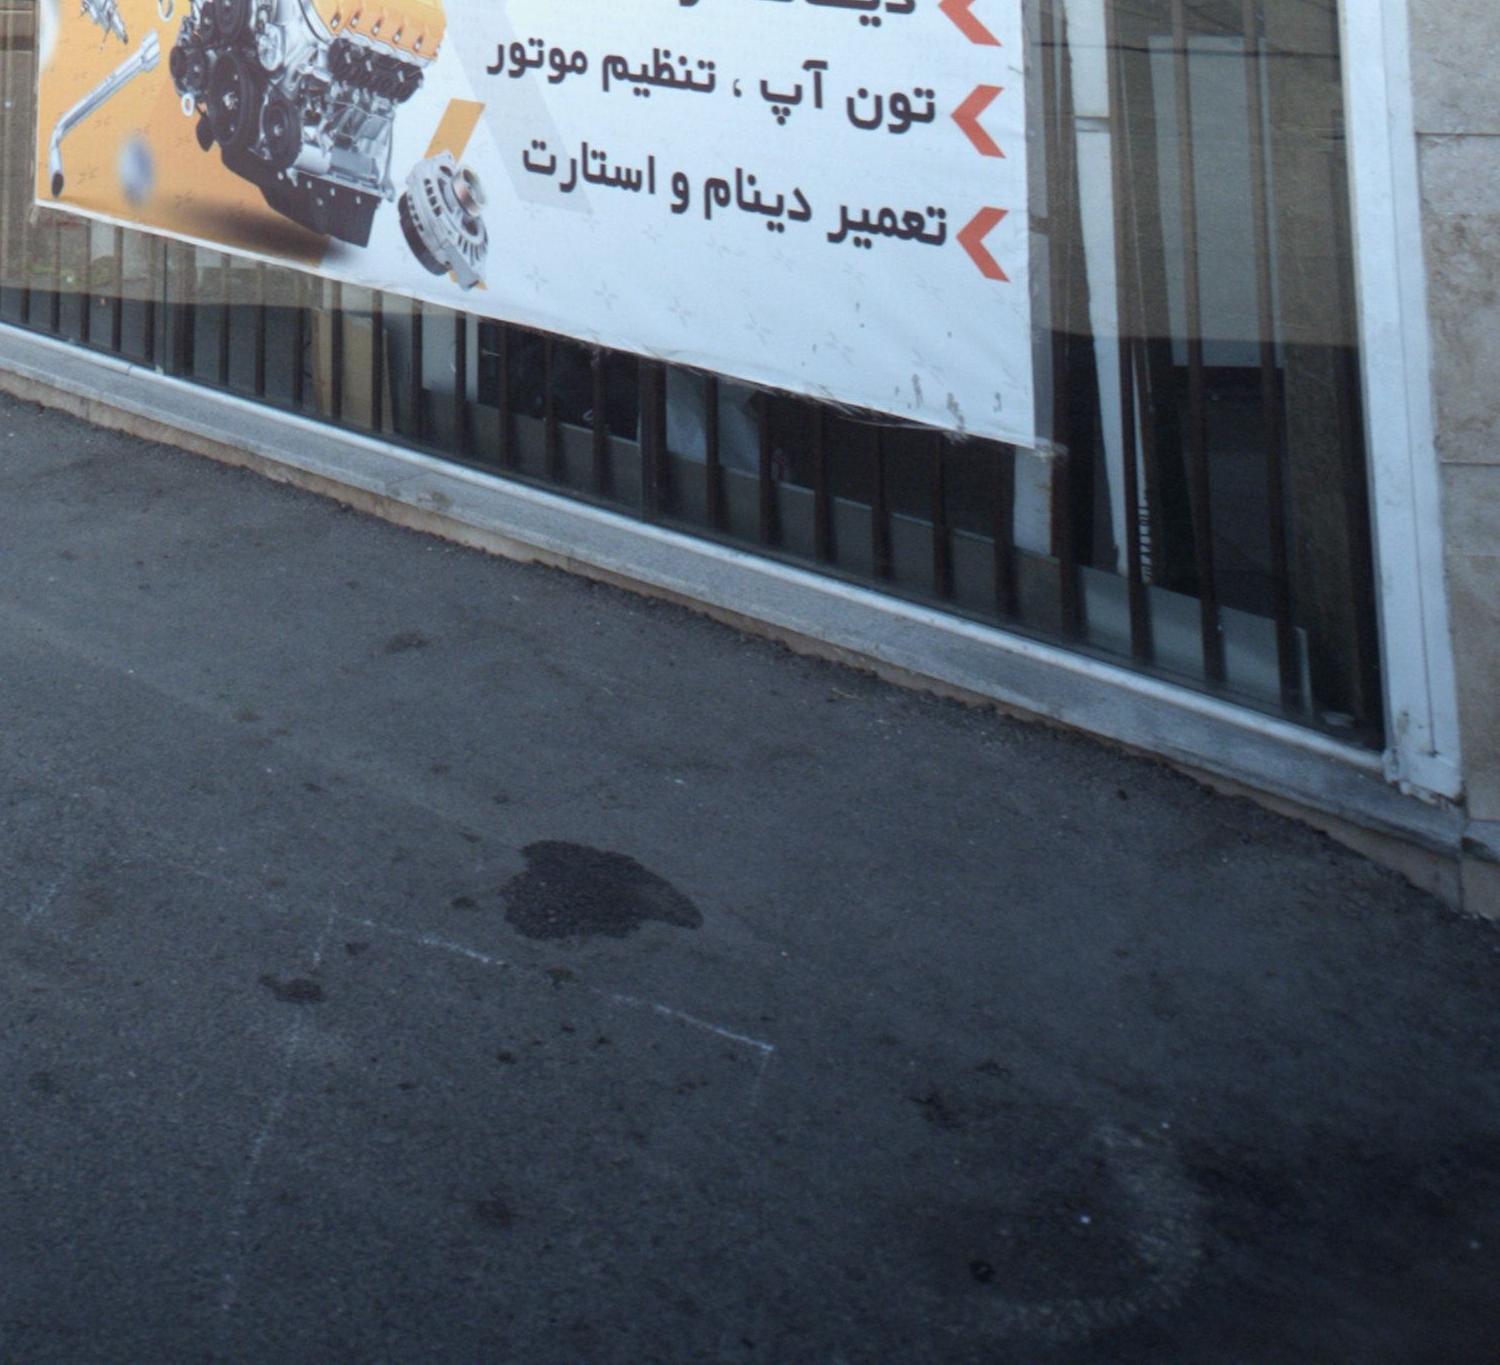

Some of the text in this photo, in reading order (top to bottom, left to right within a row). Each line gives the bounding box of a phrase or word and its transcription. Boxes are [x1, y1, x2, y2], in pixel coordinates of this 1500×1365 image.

[486, 37, 589, 85] موتور
[601, 47, 716, 98] تنظیم
[759, 58, 829, 126] آپ
[846, 86, 936, 135] تون
[522, 138, 948, 250] تعمیر دینام و استارت
